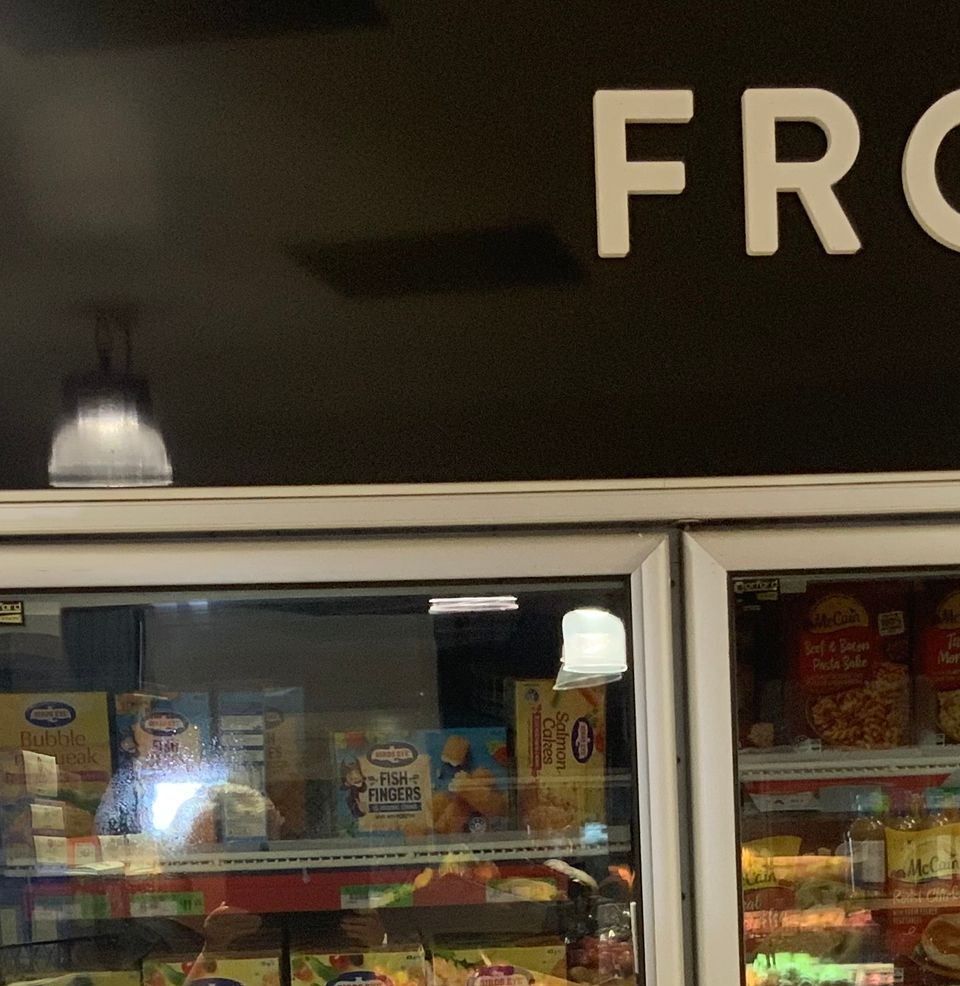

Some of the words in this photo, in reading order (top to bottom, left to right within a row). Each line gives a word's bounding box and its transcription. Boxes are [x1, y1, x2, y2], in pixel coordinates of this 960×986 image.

[20, 730, 87, 748] Bubble
[542, 717, 556, 765] Cakes
[554, 711, 569, 771] Salmon
[380, 772, 408, 786] FISH
[368, 786, 421, 803] FINGERS
[907, 855, 959, 876] McCain
